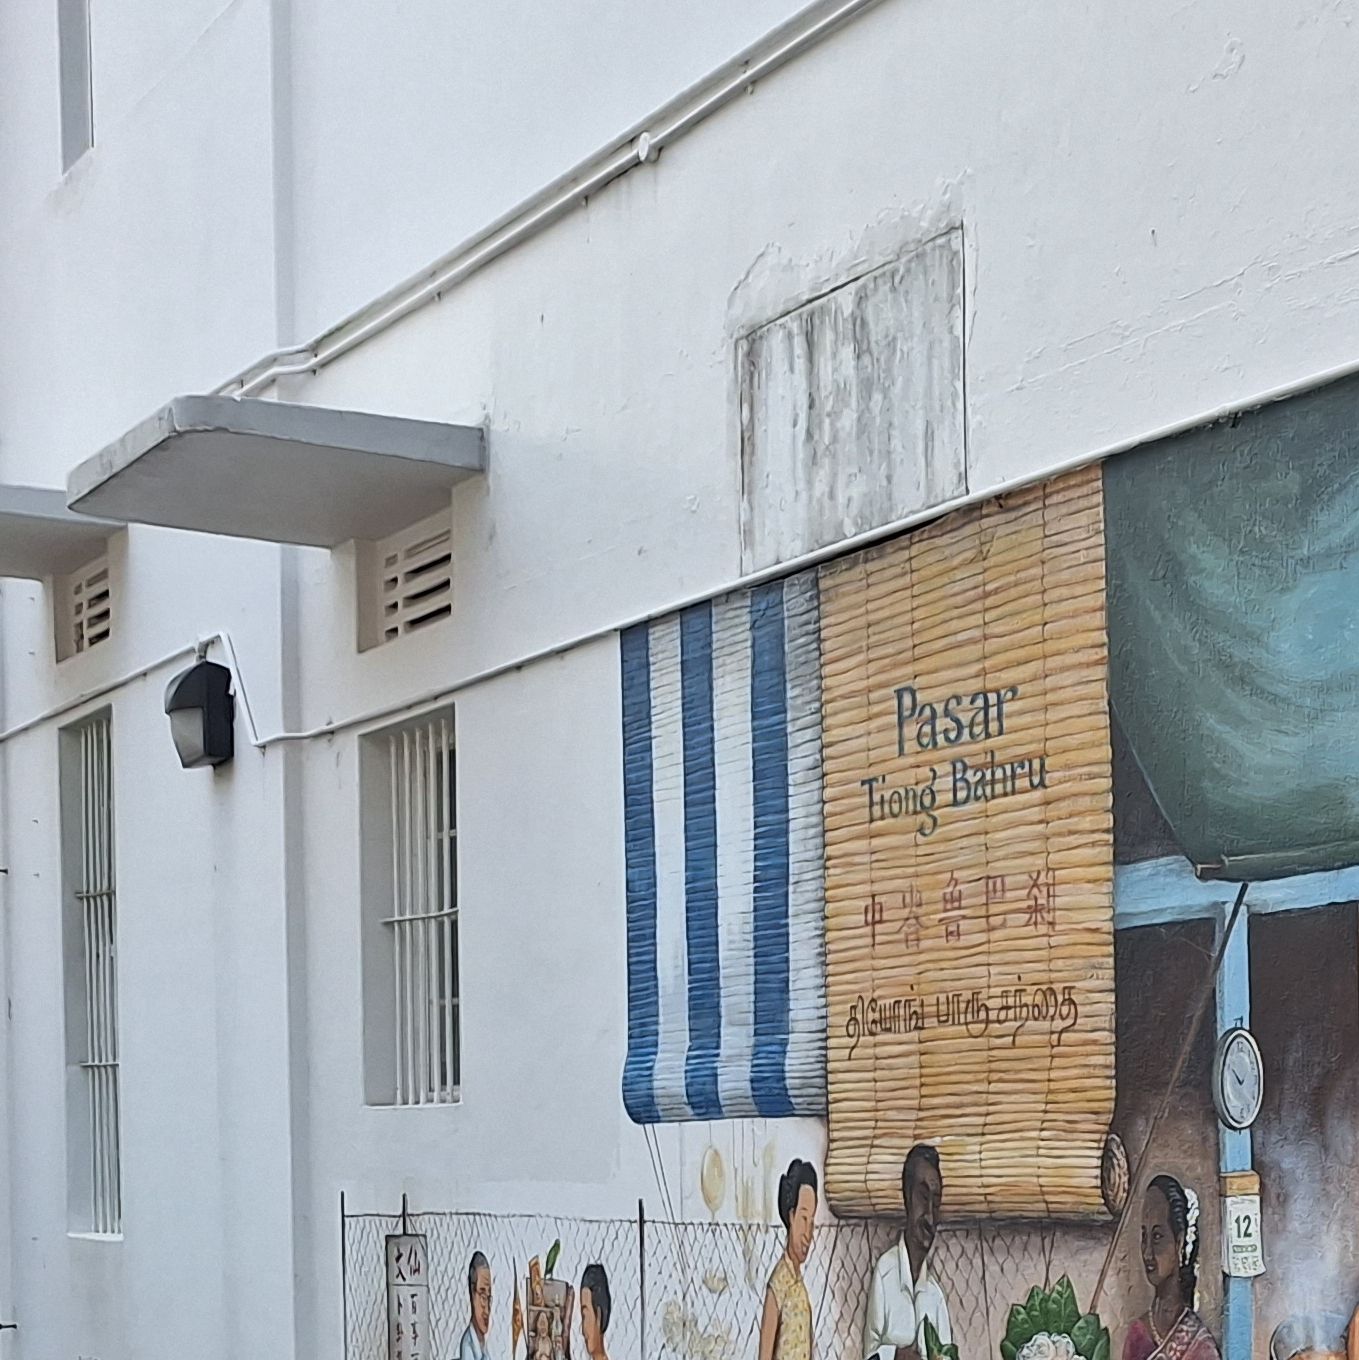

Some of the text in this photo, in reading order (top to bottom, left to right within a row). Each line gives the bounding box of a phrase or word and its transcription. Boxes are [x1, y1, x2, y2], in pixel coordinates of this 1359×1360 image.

[893, 685, 1019, 758] Pasar
[860, 750, 1048, 838] Tiong Bahru
[1234, 1213, 1253, 1239] 12
